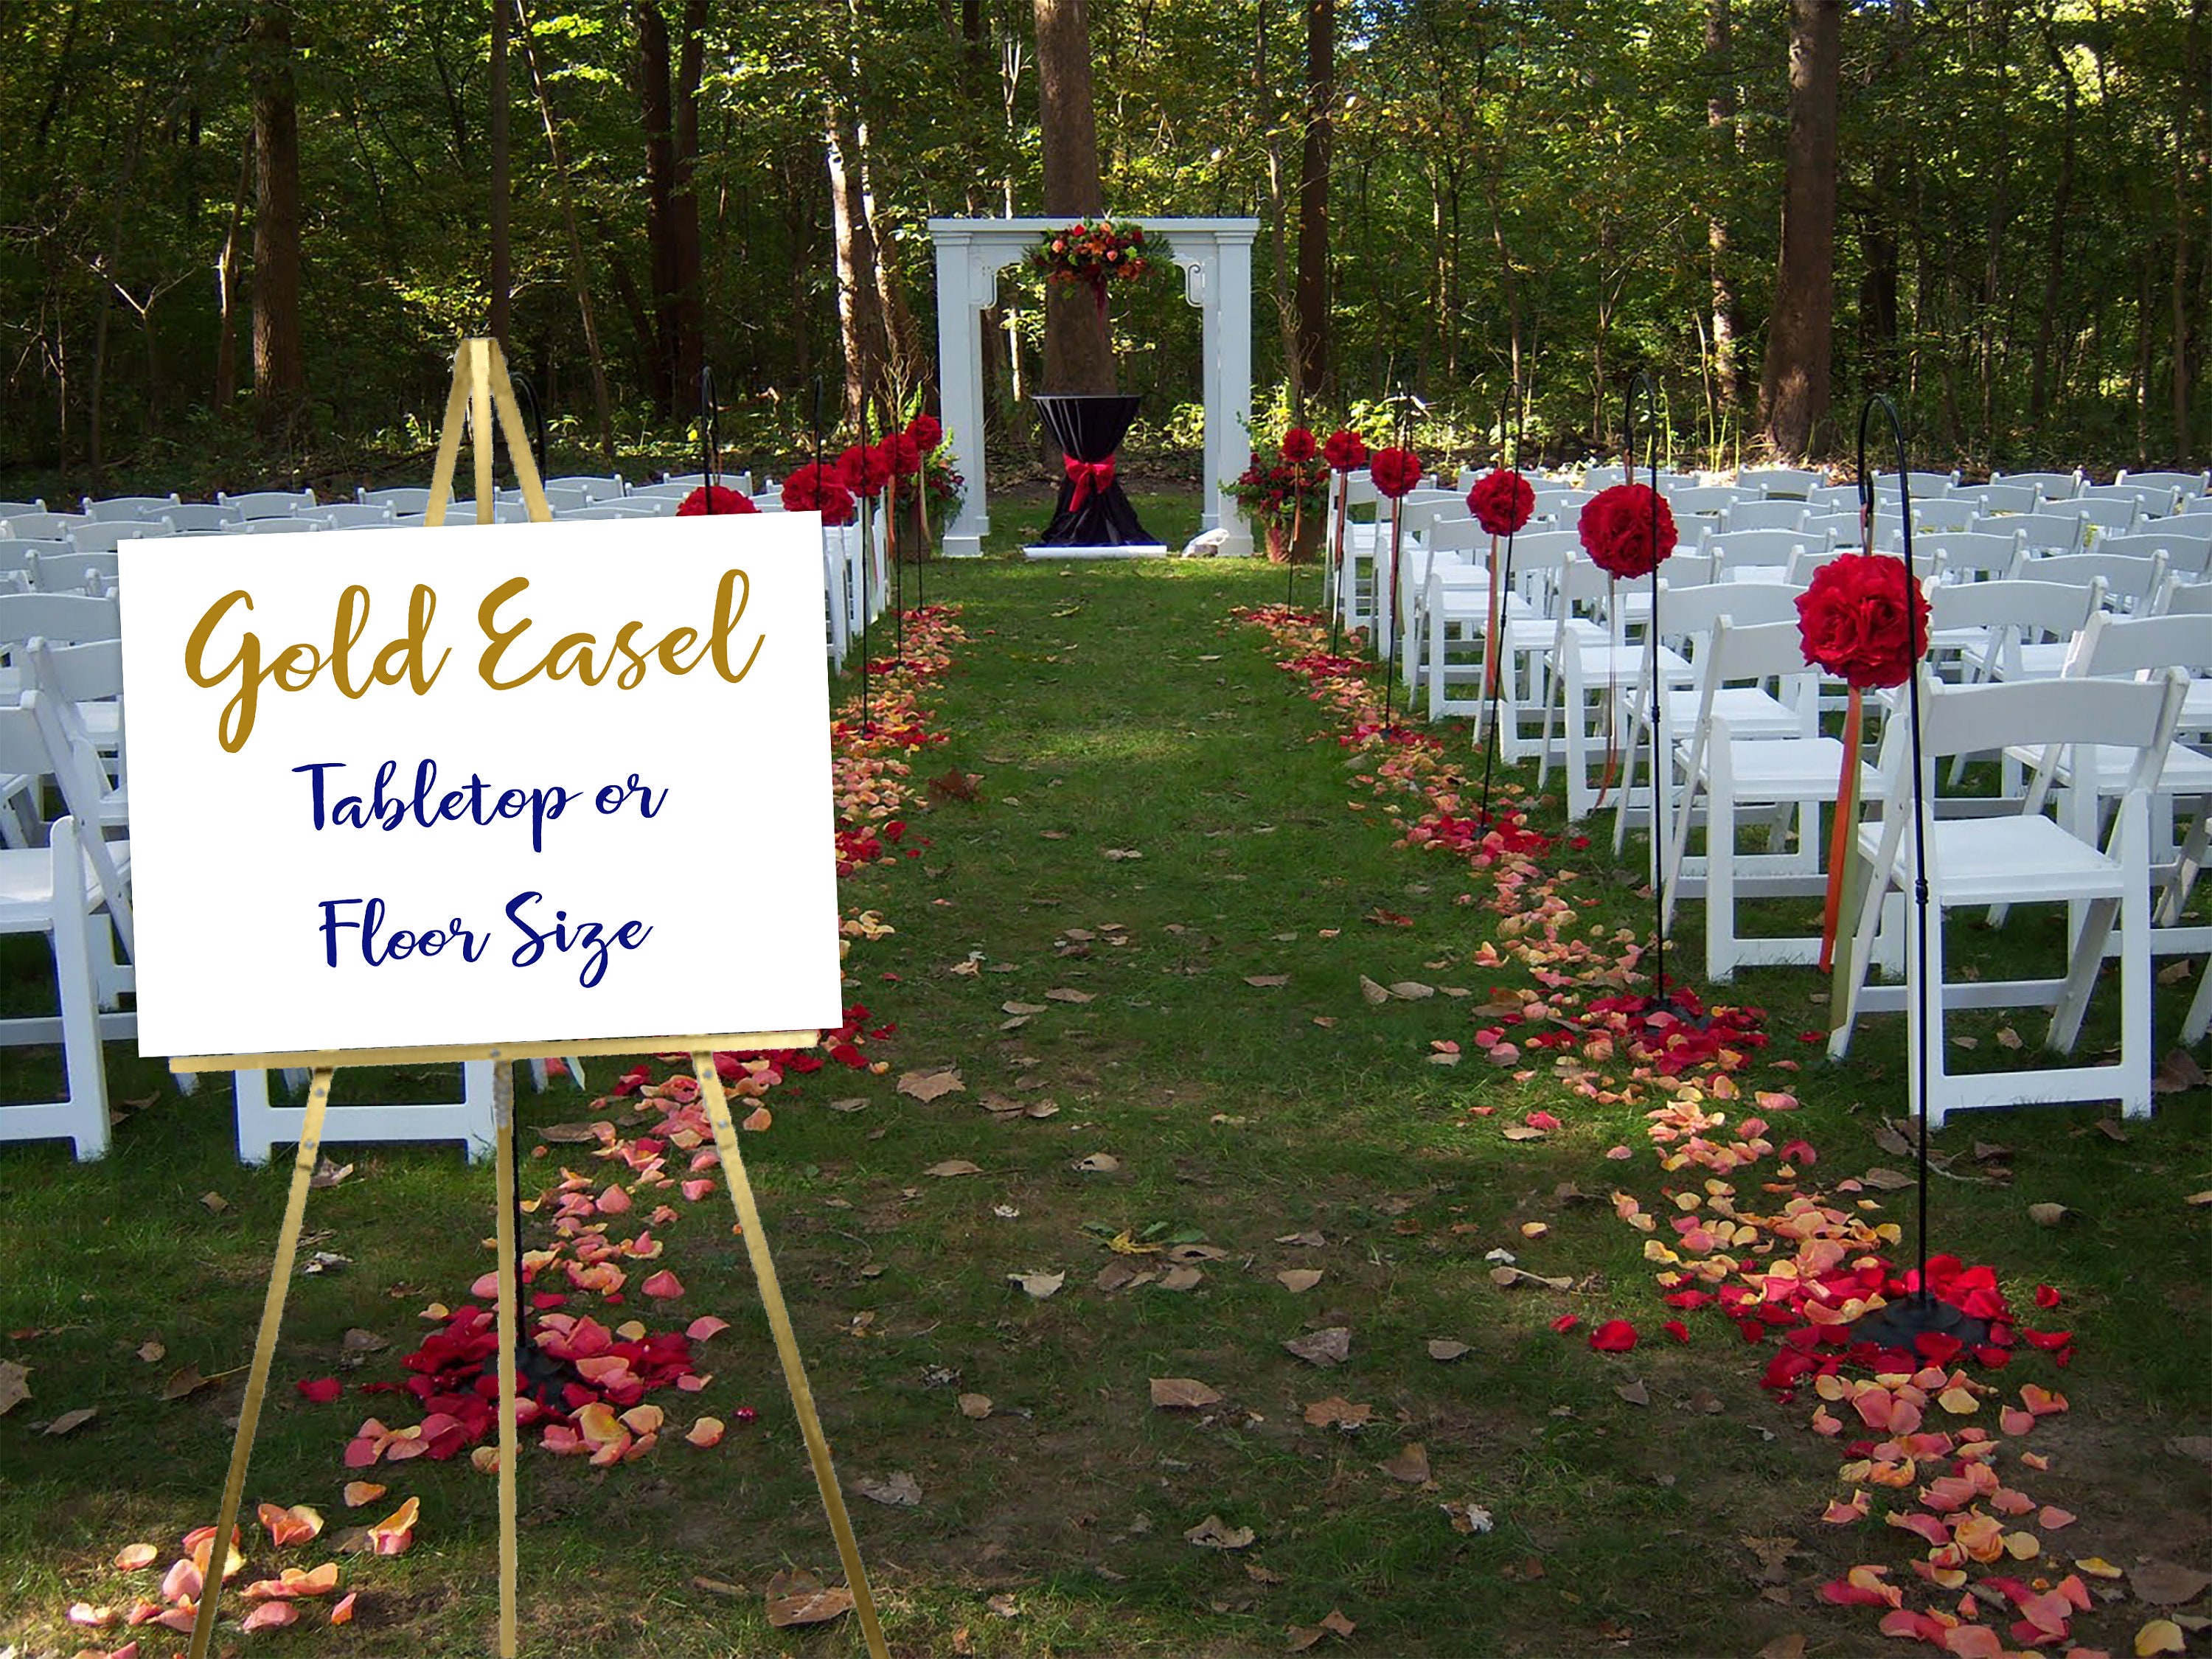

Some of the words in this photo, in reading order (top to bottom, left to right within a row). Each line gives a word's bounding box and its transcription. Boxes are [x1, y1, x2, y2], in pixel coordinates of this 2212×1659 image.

[184, 583, 453, 754] Gold
[477, 568, 766, 691] Easel
[291, 758, 584, 853] Tabletop
[595, 773, 669, 818] or
[318, 897, 492, 968] Floor
[505, 891, 654, 989] Size
